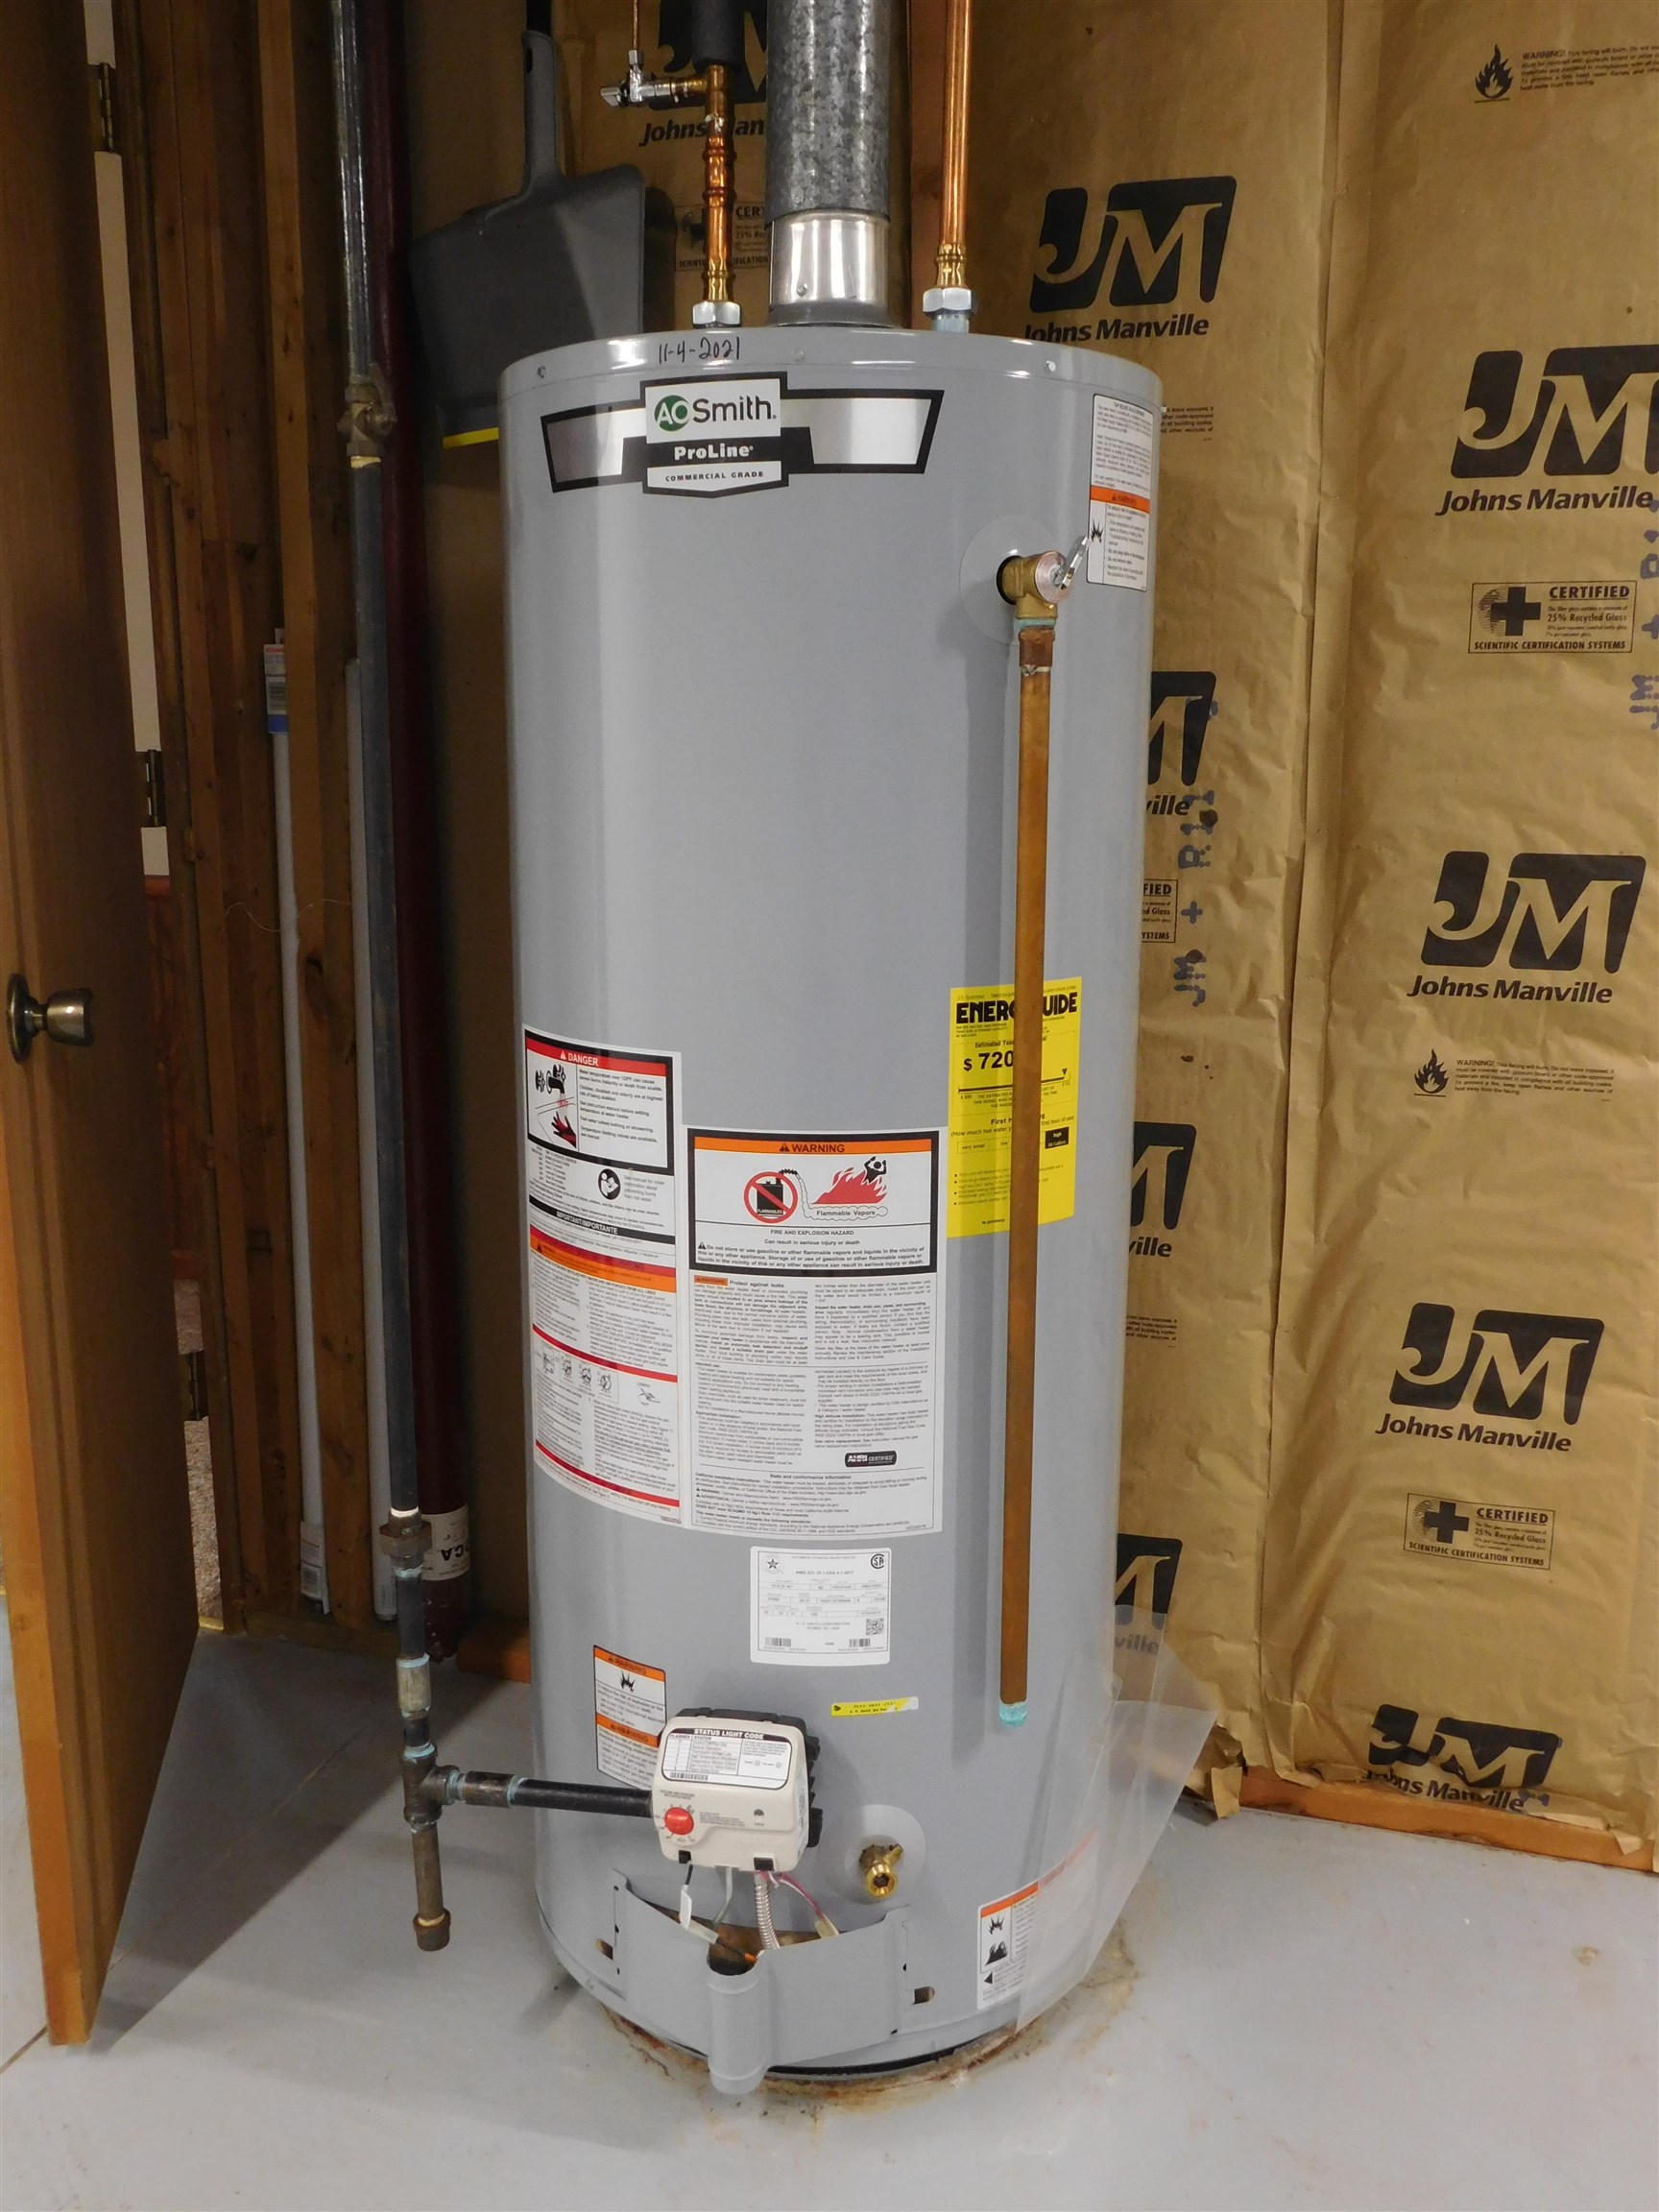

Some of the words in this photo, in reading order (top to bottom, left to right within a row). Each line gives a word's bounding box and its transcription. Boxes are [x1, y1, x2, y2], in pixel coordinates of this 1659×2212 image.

[1029, 176, 1237, 313] JM
[1095, 313, 1209, 340] Manville
[1451, 345, 1659, 478] JM
[665, 472, 726, 482] COMMERCIAL
[1434, 489, 1523, 516] Johns
[1527, 485, 1653, 510] Manville
[1550, 586, 1629, 598] CERTIFIED
[1548, 613, 1567, 622] 25%
[1570, 613, 1603, 623] Recycled
[1605, 613, 1626, 622] Glass
[1475, 641, 1518, 650] SCIENTIFIC
[1522, 640, 1584, 650] CERTIFICATION
[1588, 640, 1625, 649] SYSTEMS
[1421, 851, 1647, 974] JM
[1407, 974, 1489, 998] Johns
[1493, 979, 1612, 1003] Manville
[567, 1052, 599, 1067] DANGER
[978, 1050, 1014, 1070] 720
[1129, 1237, 1172, 1258] ville
[1389, 1302, 1604, 1425] JM
[1375, 1413, 1454, 1440] Johns
[1456, 1423, 1572, 1452] Manville
[1477, 1508, 1548, 1524] CERTIFIED
[1495, 1531, 1525, 1541] Recycled
[1409, 1542, 1449, 1554] SCIENTIFIC
[1452, 1549, 1507, 1562] CERTIFICATION
[1510, 1555, 1544, 1566] SYSTEMS
[1115, 1634, 1159, 1655] ville
